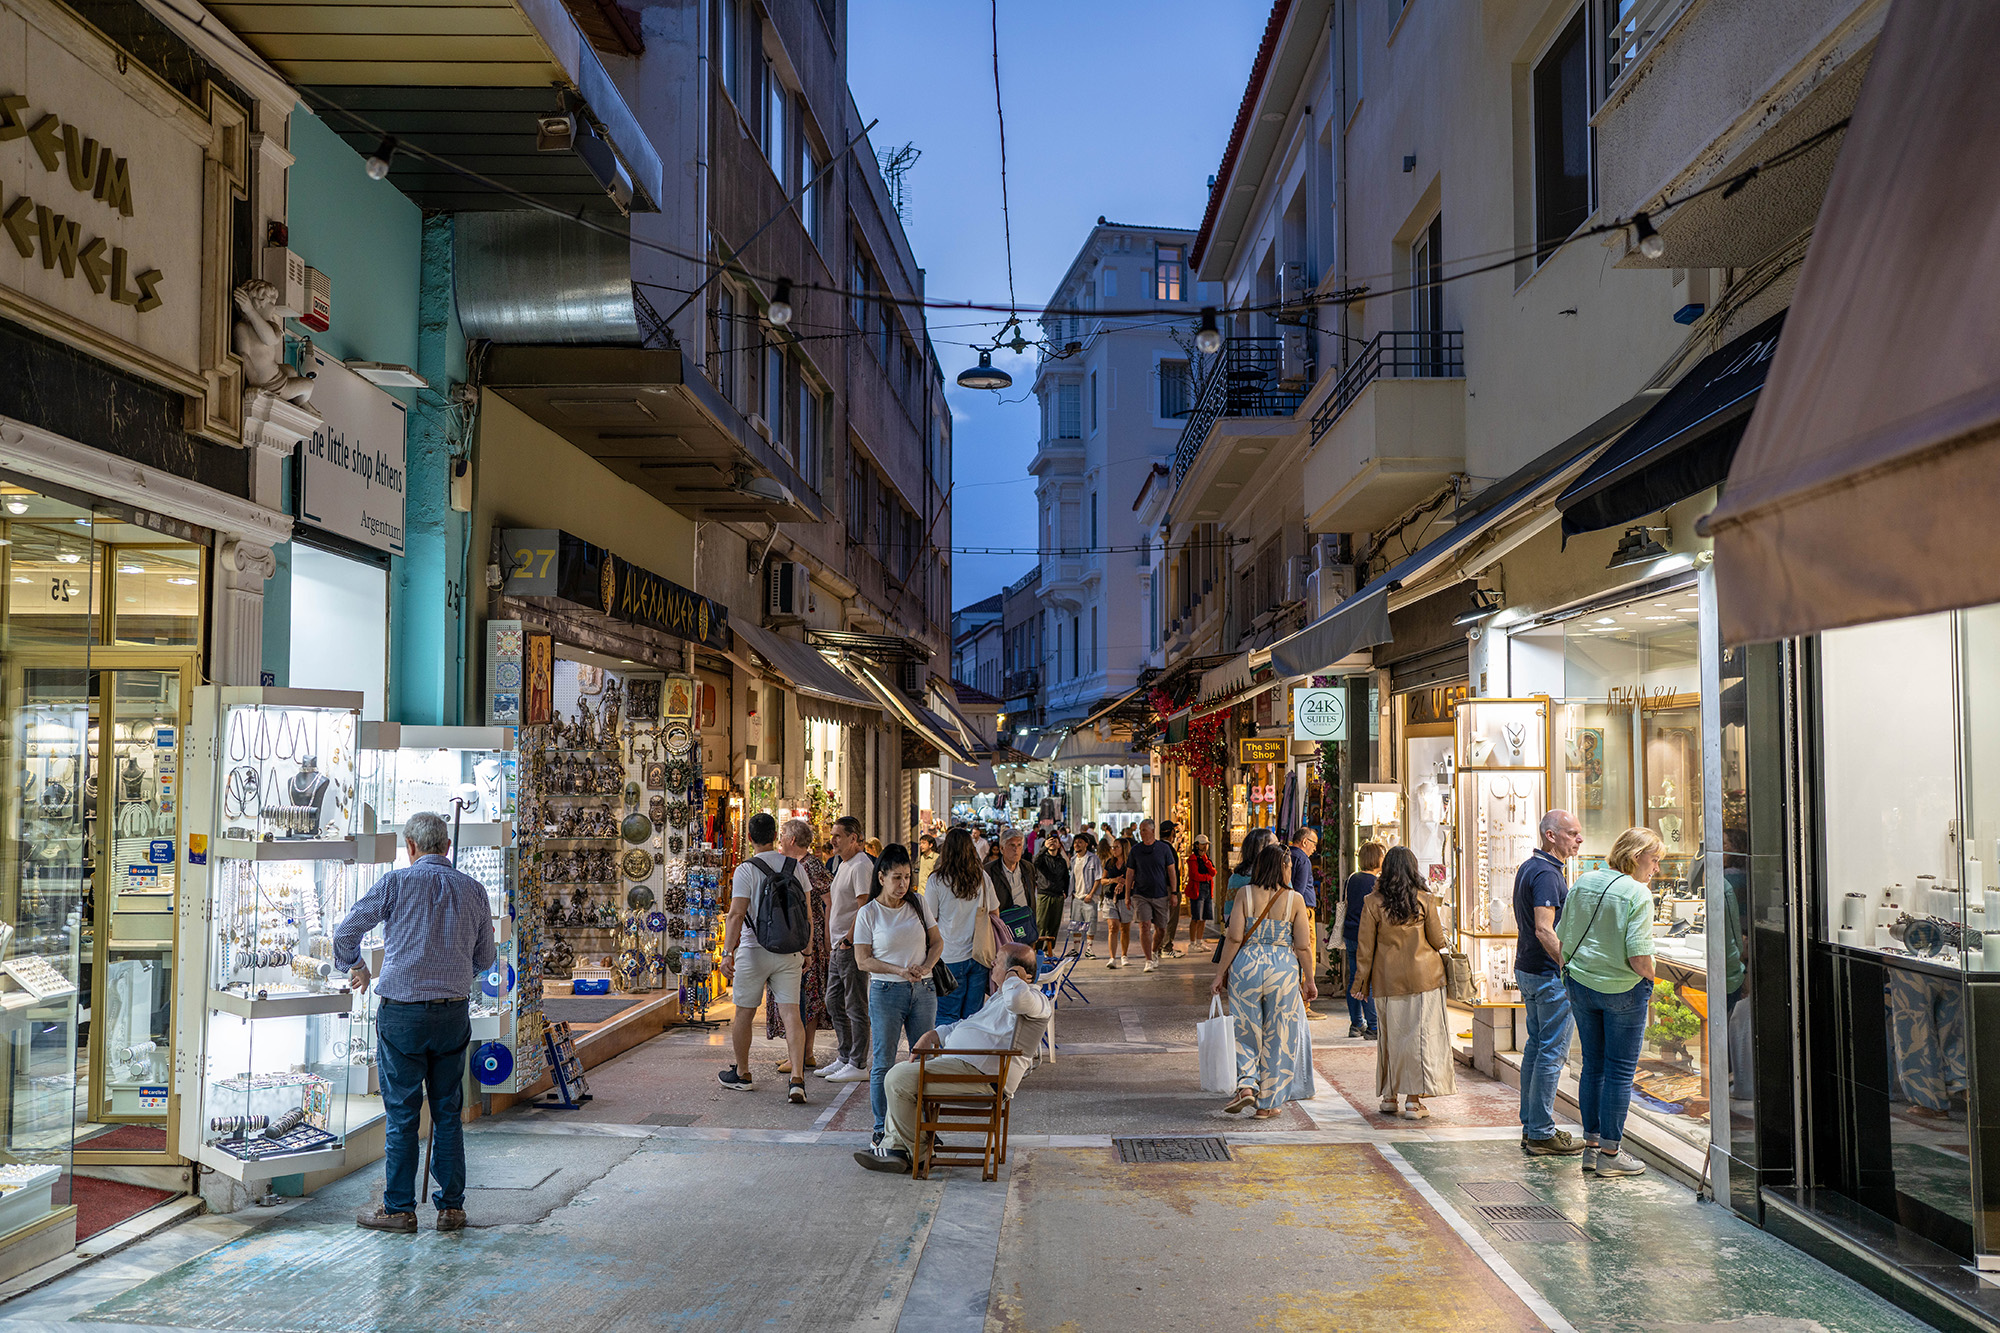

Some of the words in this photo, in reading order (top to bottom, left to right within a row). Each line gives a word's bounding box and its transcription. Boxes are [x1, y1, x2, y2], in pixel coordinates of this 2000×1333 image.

[0, 180, 164, 313] EWELS
[327, 426, 350, 470] little
[352, 440, 373, 489] shop
[375, 450, 402, 493] Athens
[361, 510, 401, 541] Argentum
[513, 549, 556, 579] 27
[622, 571, 695, 633] ALEXANDER
[1307, 700, 1336, 712] 24K
[1606, 683, 1649, 716] ATHENA
[1652, 685, 1678, 718] Gold
[1246, 743, 1262, 751] The
[1264, 742, 1281, 750] Silk
[1252, 751, 1275, 759] Shop
